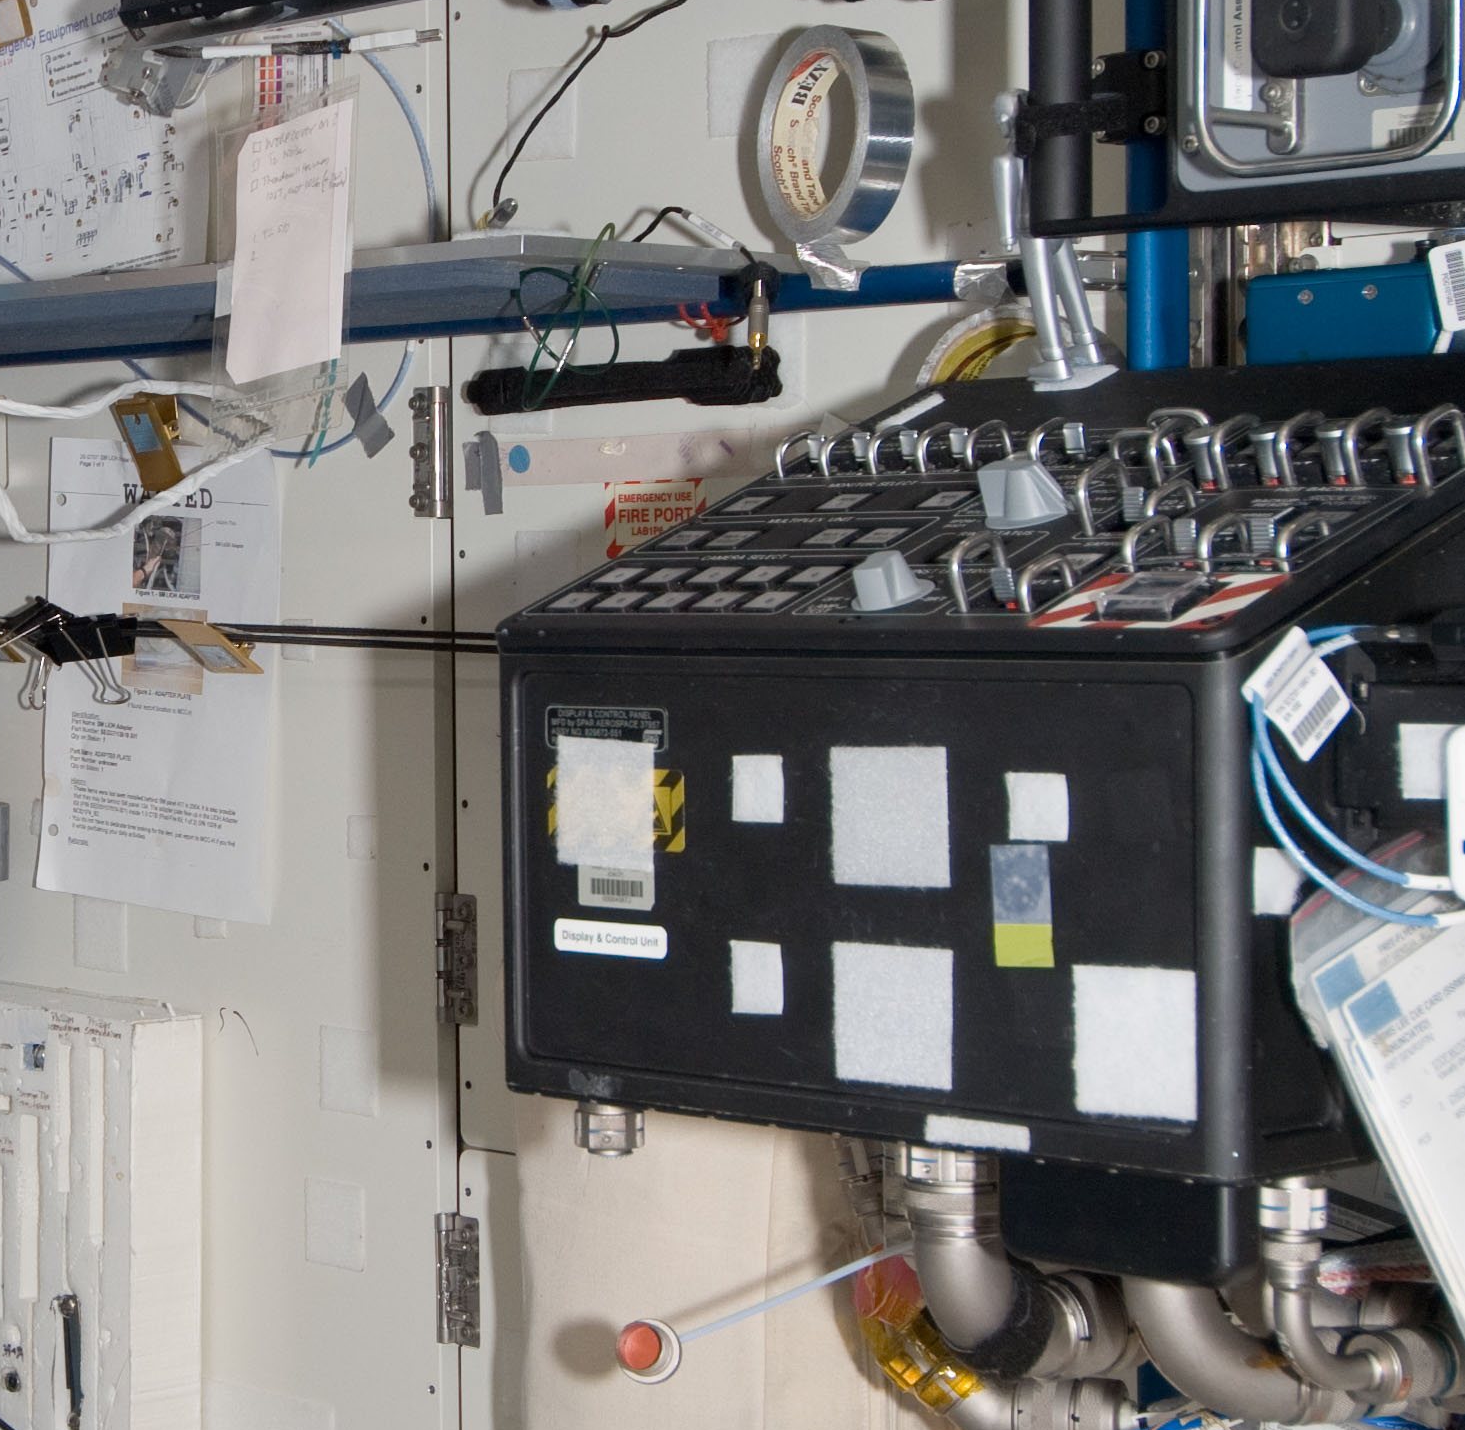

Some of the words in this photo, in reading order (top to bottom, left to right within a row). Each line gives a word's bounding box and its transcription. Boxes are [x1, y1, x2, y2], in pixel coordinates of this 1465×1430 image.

[38, 18, 89, 44] Equipment
[789, 171, 806, 201] Brand
[123, 482, 213, 509] WAED
[618, 492, 673, 504] EMERGENCY
[674, 491, 693, 501] USE
[618, 508, 650, 523] FIRE
[653, 506, 693, 522] PORT
[557, 709, 586, 719] DISPLAY
[594, 709, 627, 719] CONTROL
[628, 710, 652, 720] PANEL
[596, 720, 639, 730] AEROSPACE
[561, 929, 595, 943] Display
[597, 933, 603, 943] &
[604, 933, 639, 946] Control
[640, 935, 659, 947] Unit
